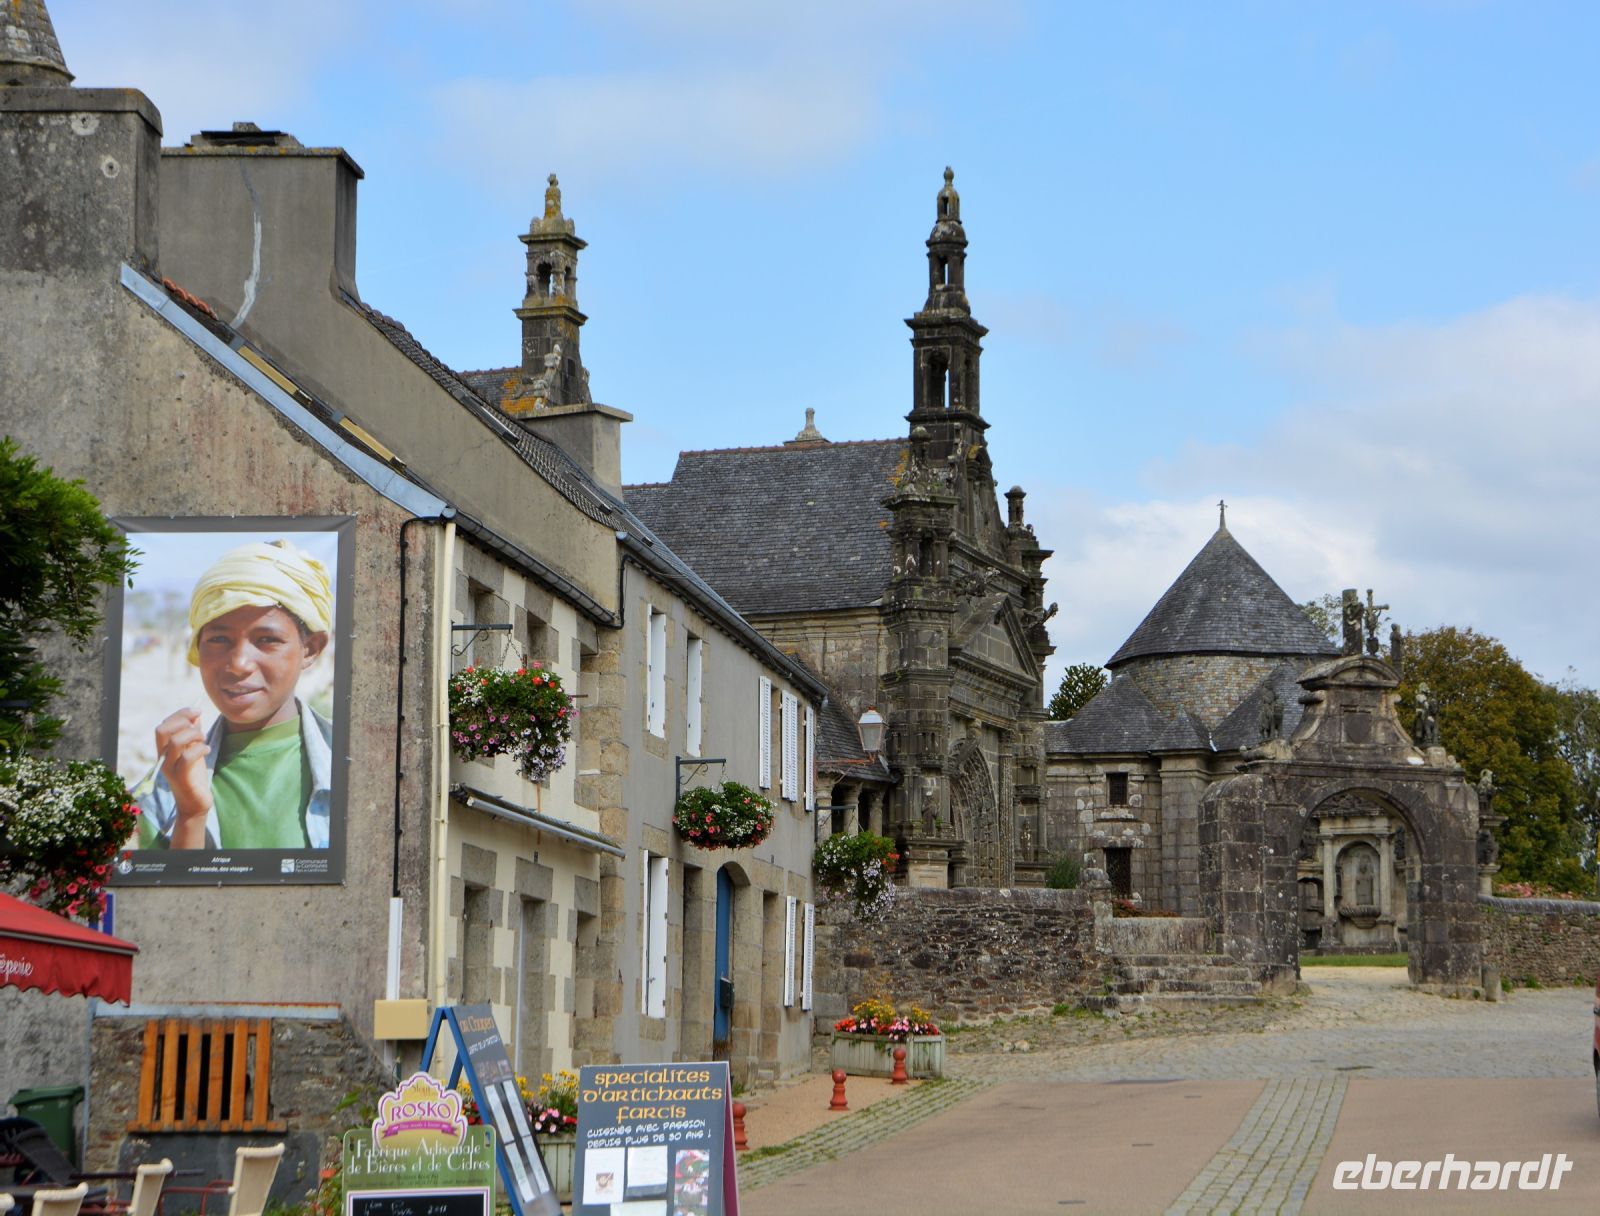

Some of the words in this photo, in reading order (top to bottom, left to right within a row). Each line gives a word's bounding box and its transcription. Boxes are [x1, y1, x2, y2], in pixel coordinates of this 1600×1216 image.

[391, 1102, 451, 1121] ROSKO
[616, 1104, 687, 1124] farcis
[636, 1123, 659, 1133] AVEC
[662, 1119, 706, 1131] PASSION
[356, 1138, 411, 1161] Fabrique
[416, 1135, 481, 1156] Artisanale
[587, 1138, 622, 1149] DEPUIS
[625, 1136, 649, 1145] PLUS
[652, 1134, 665, 1143] DE
[668, 1132, 681, 1141] 30
[685, 1130, 704, 1140] ANS
[347, 1155, 361, 1174] de
[367, 1154, 406, 1174] Bières
[412, 1156, 422, 1172] et
[428, 1153, 442, 1171] de
[447, 1150, 491, 1171] Cidres
